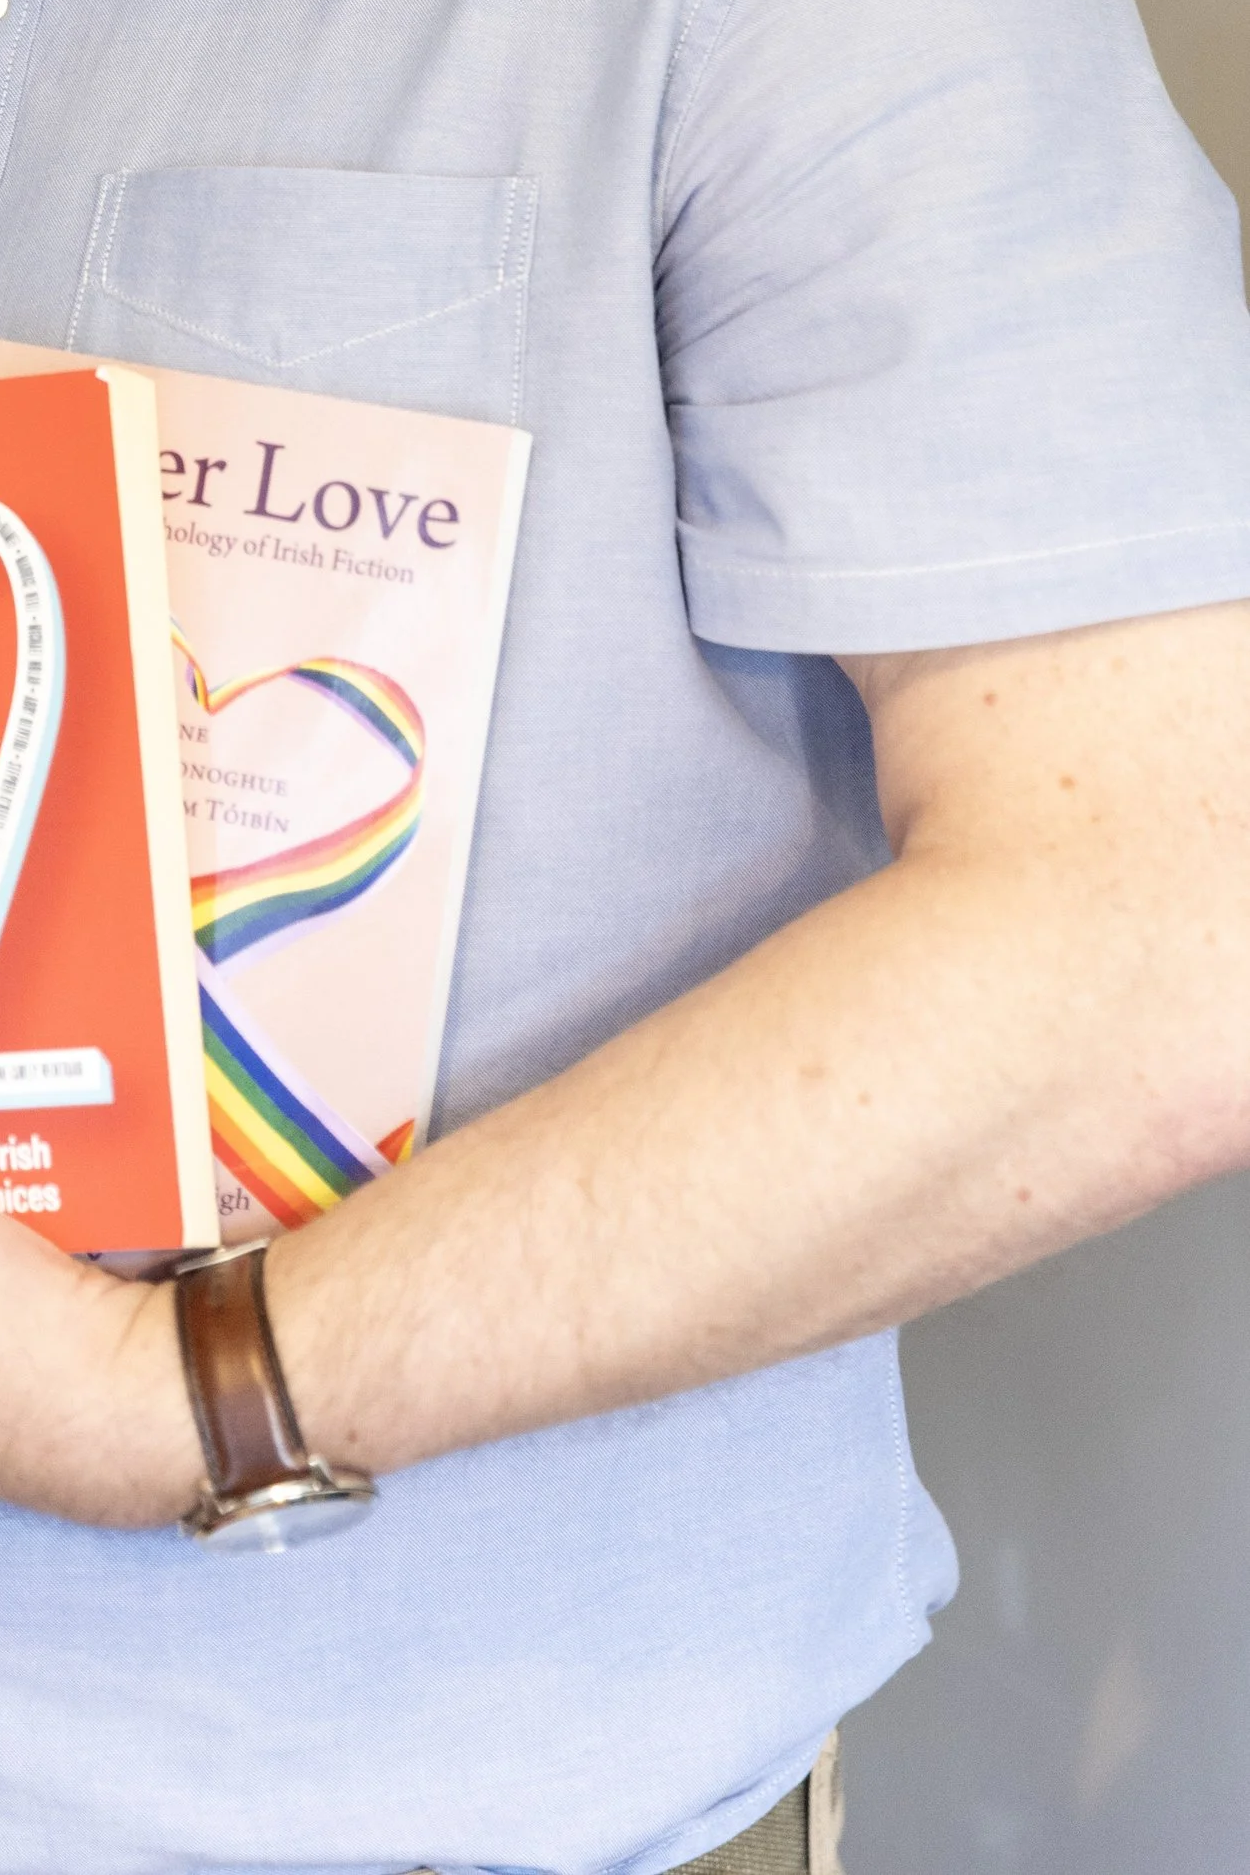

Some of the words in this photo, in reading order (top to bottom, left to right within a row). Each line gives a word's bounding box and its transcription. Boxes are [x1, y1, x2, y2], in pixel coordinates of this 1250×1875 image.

[159, 447, 228, 509] er
[243, 439, 462, 551] Love
[242, 534, 269, 558] of
[272, 537, 326, 571] Irish
[330, 546, 416, 586] Fiction
[178, 724, 211, 746] NE
[203, 797, 292, 836] TÓIBÍN
[216, 1186, 250, 1217] gh
